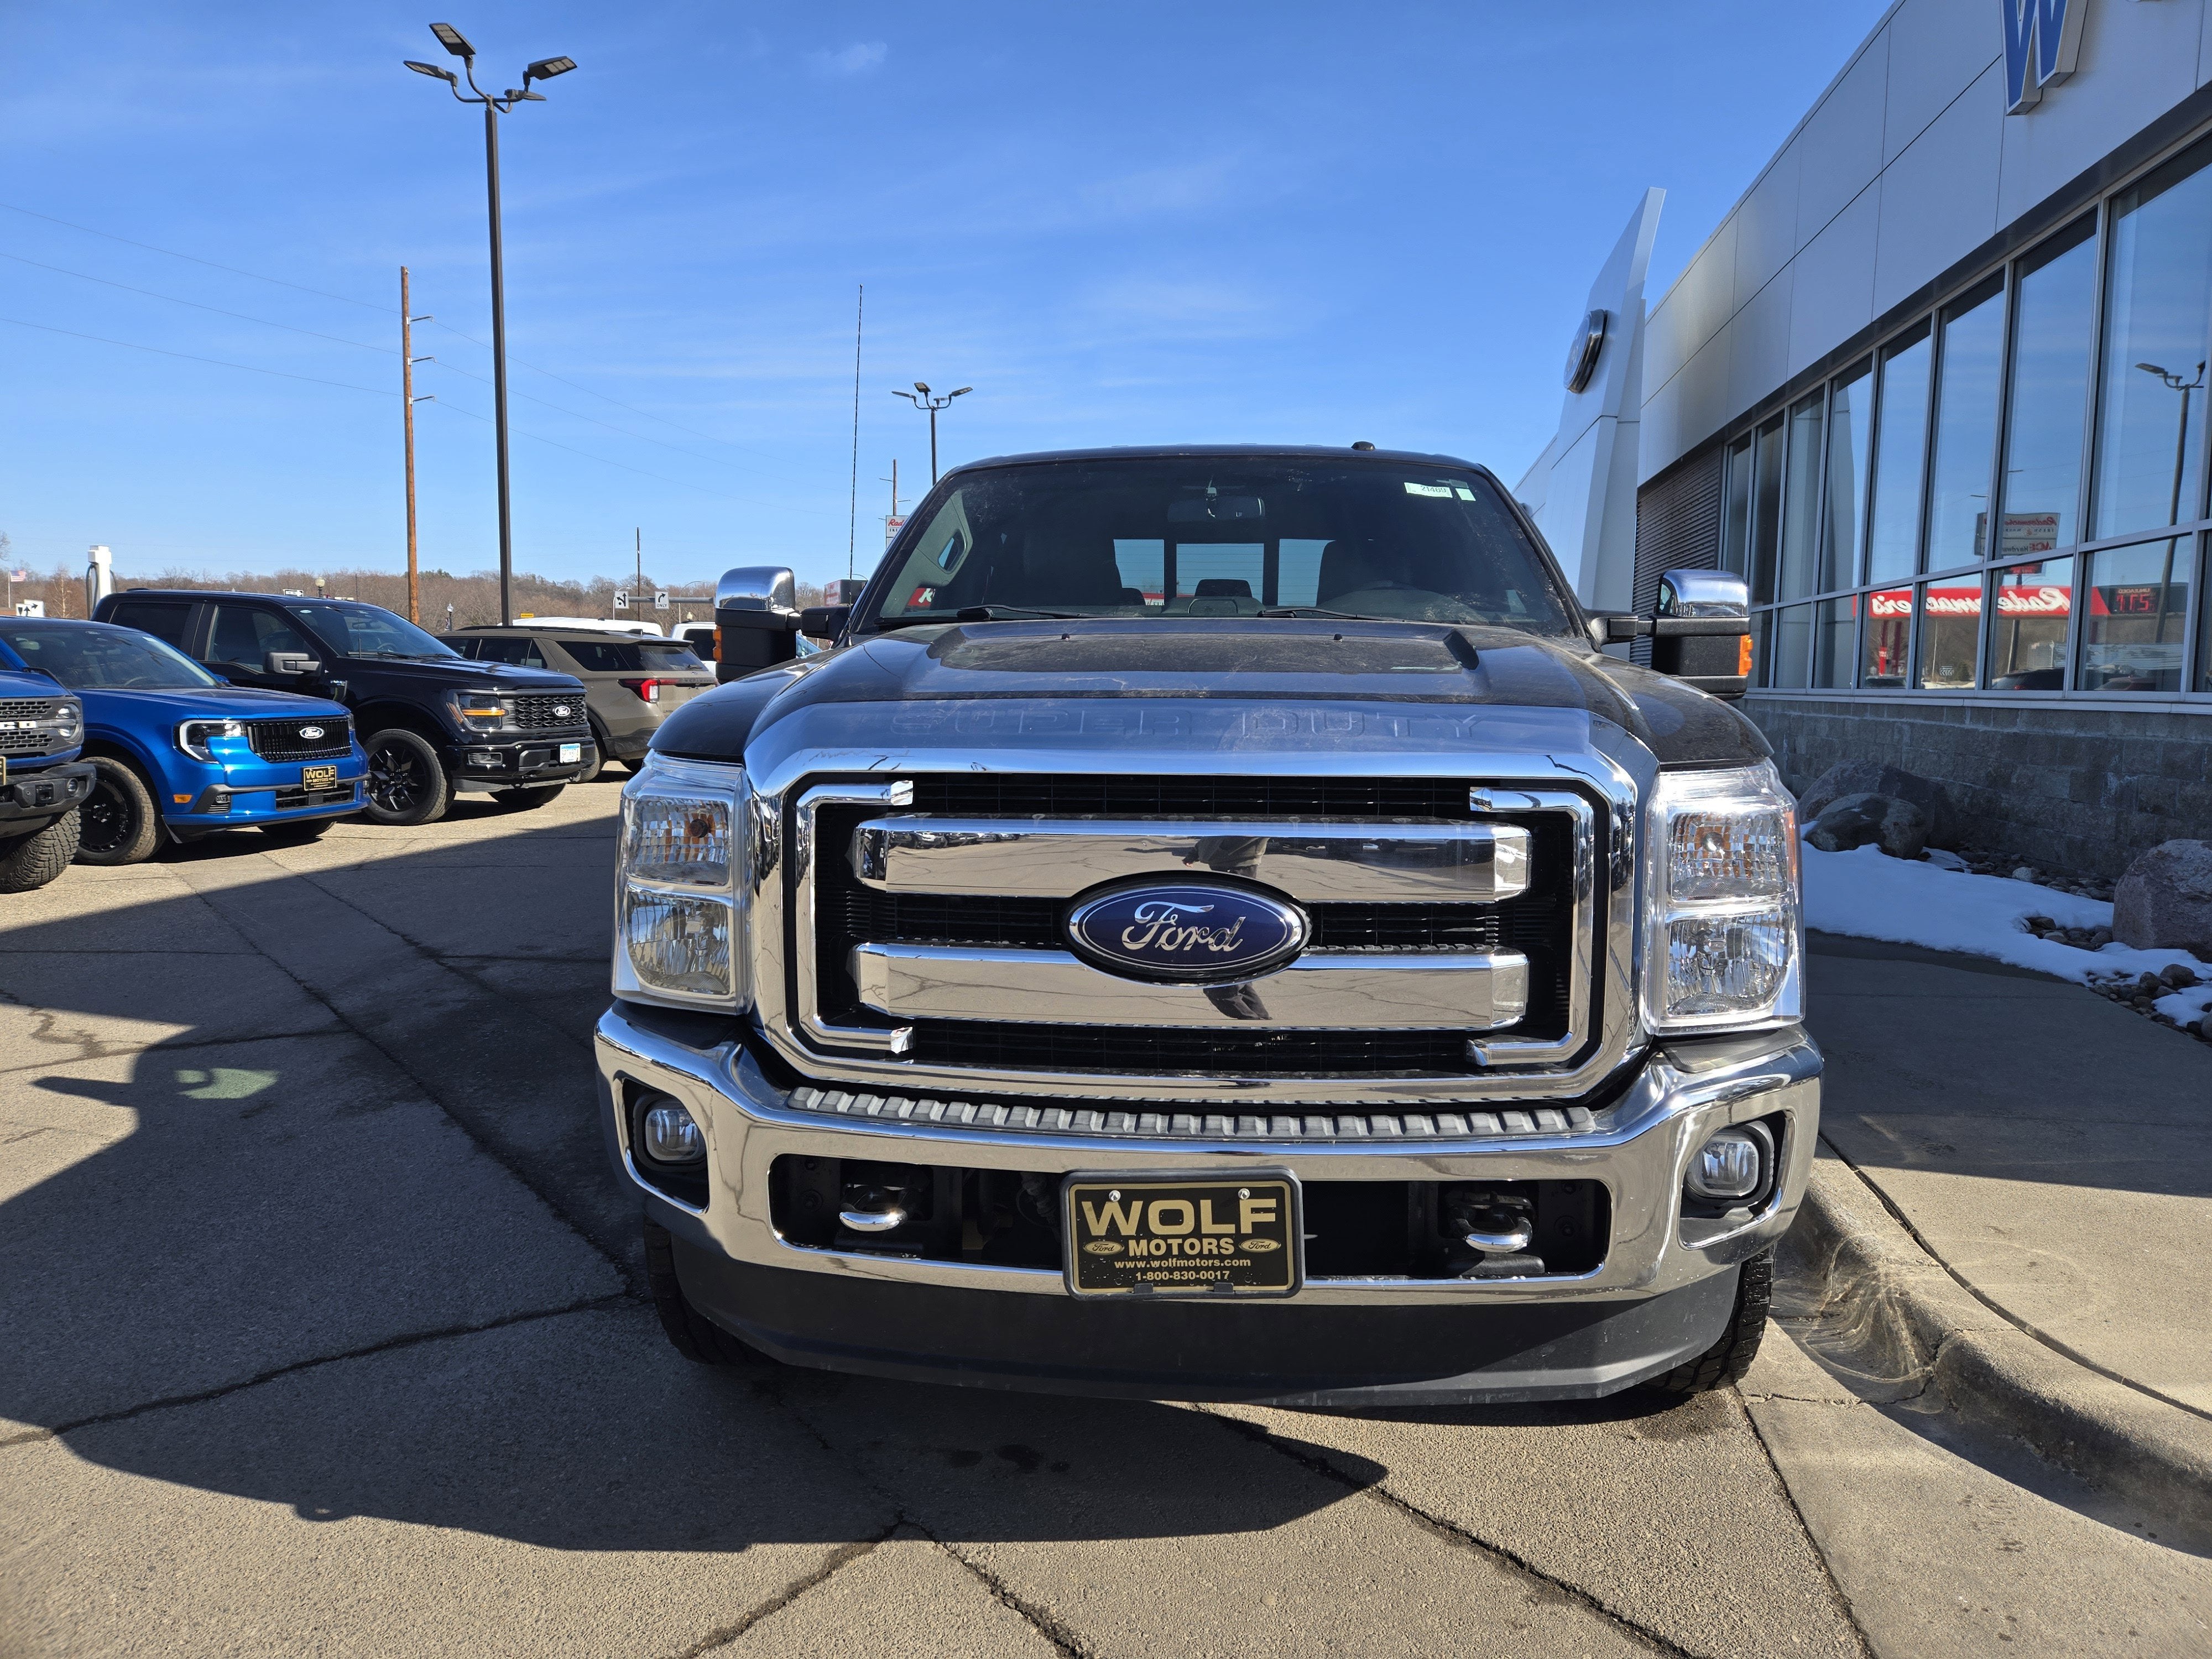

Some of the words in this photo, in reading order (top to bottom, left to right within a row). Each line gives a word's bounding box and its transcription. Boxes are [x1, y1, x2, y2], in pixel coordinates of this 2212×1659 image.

[890, 709, 1192, 735] SUPER
[1242, 710, 1492, 737] DUTY
[305, 769, 335, 779] WOLF
[1121, 901, 1246, 952] Ford
[1081, 1198, 1277, 1236] WOLF
[1092, 1243, 1114, 1253] Ford
[1129, 1238, 1235, 1256] MOTORS
[1251, 1241, 1272, 1250] Ford
[1114, 1258, 1251, 1269] www.wolfmotors.com
[1135, 1270, 1230, 1281] 1-800-830-0017
